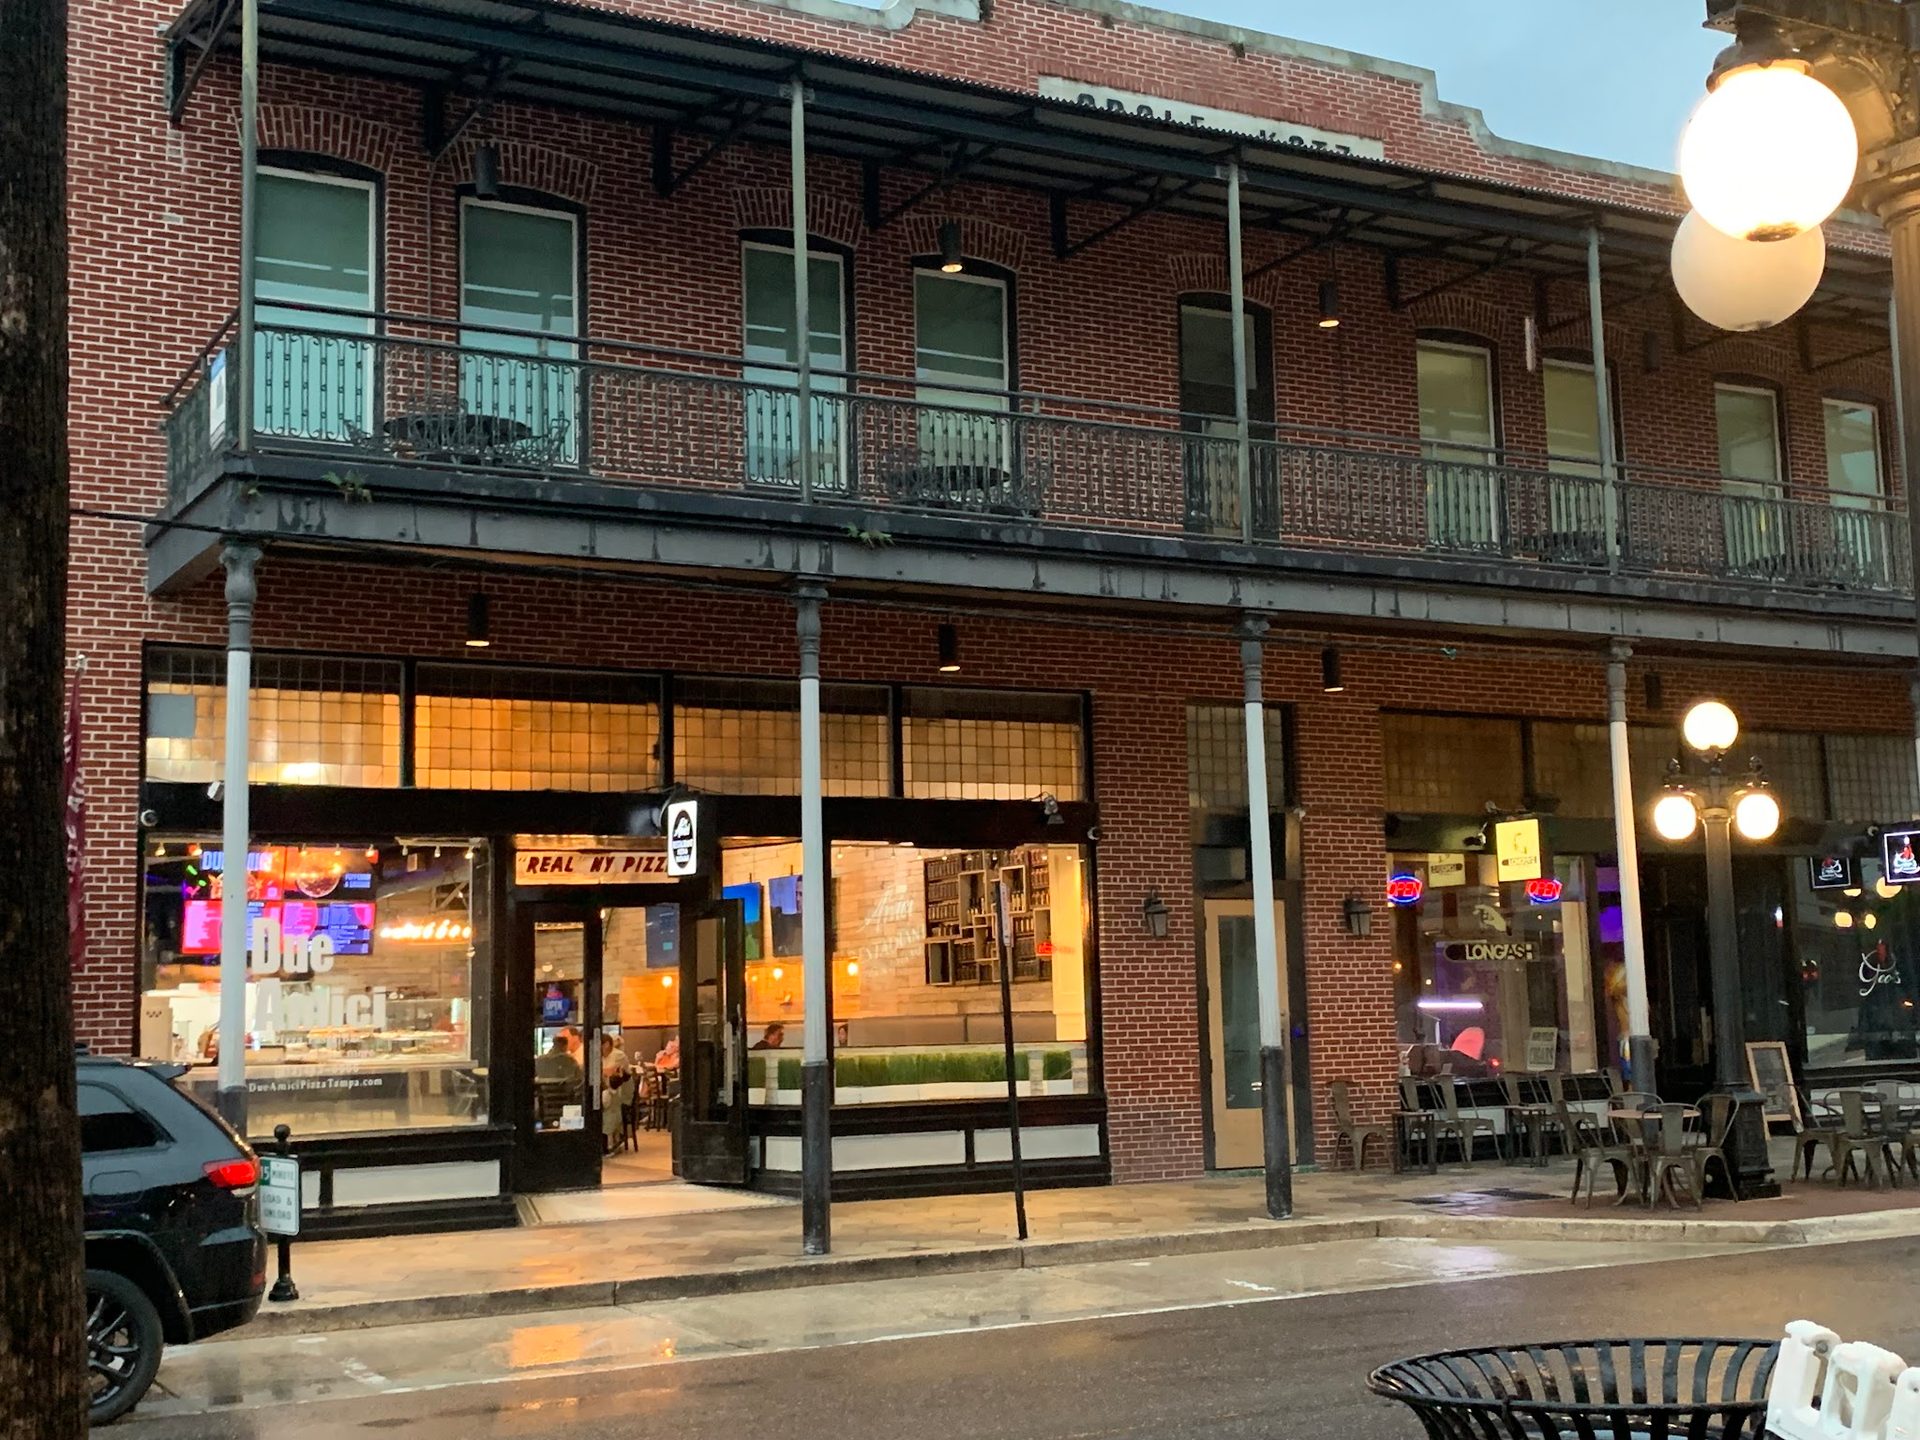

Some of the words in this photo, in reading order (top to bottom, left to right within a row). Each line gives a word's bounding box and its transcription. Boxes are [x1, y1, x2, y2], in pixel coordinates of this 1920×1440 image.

[590, 856, 615, 873] NY
[622, 856, 667, 873] PIZZ
[1389, 881, 1421, 897] OPEN
[1529, 881, 1561, 897] OPEN
[251, 917, 335, 973] Due
[1464, 943, 1533, 960] LONGASH
[254, 977, 387, 1038] Amici
